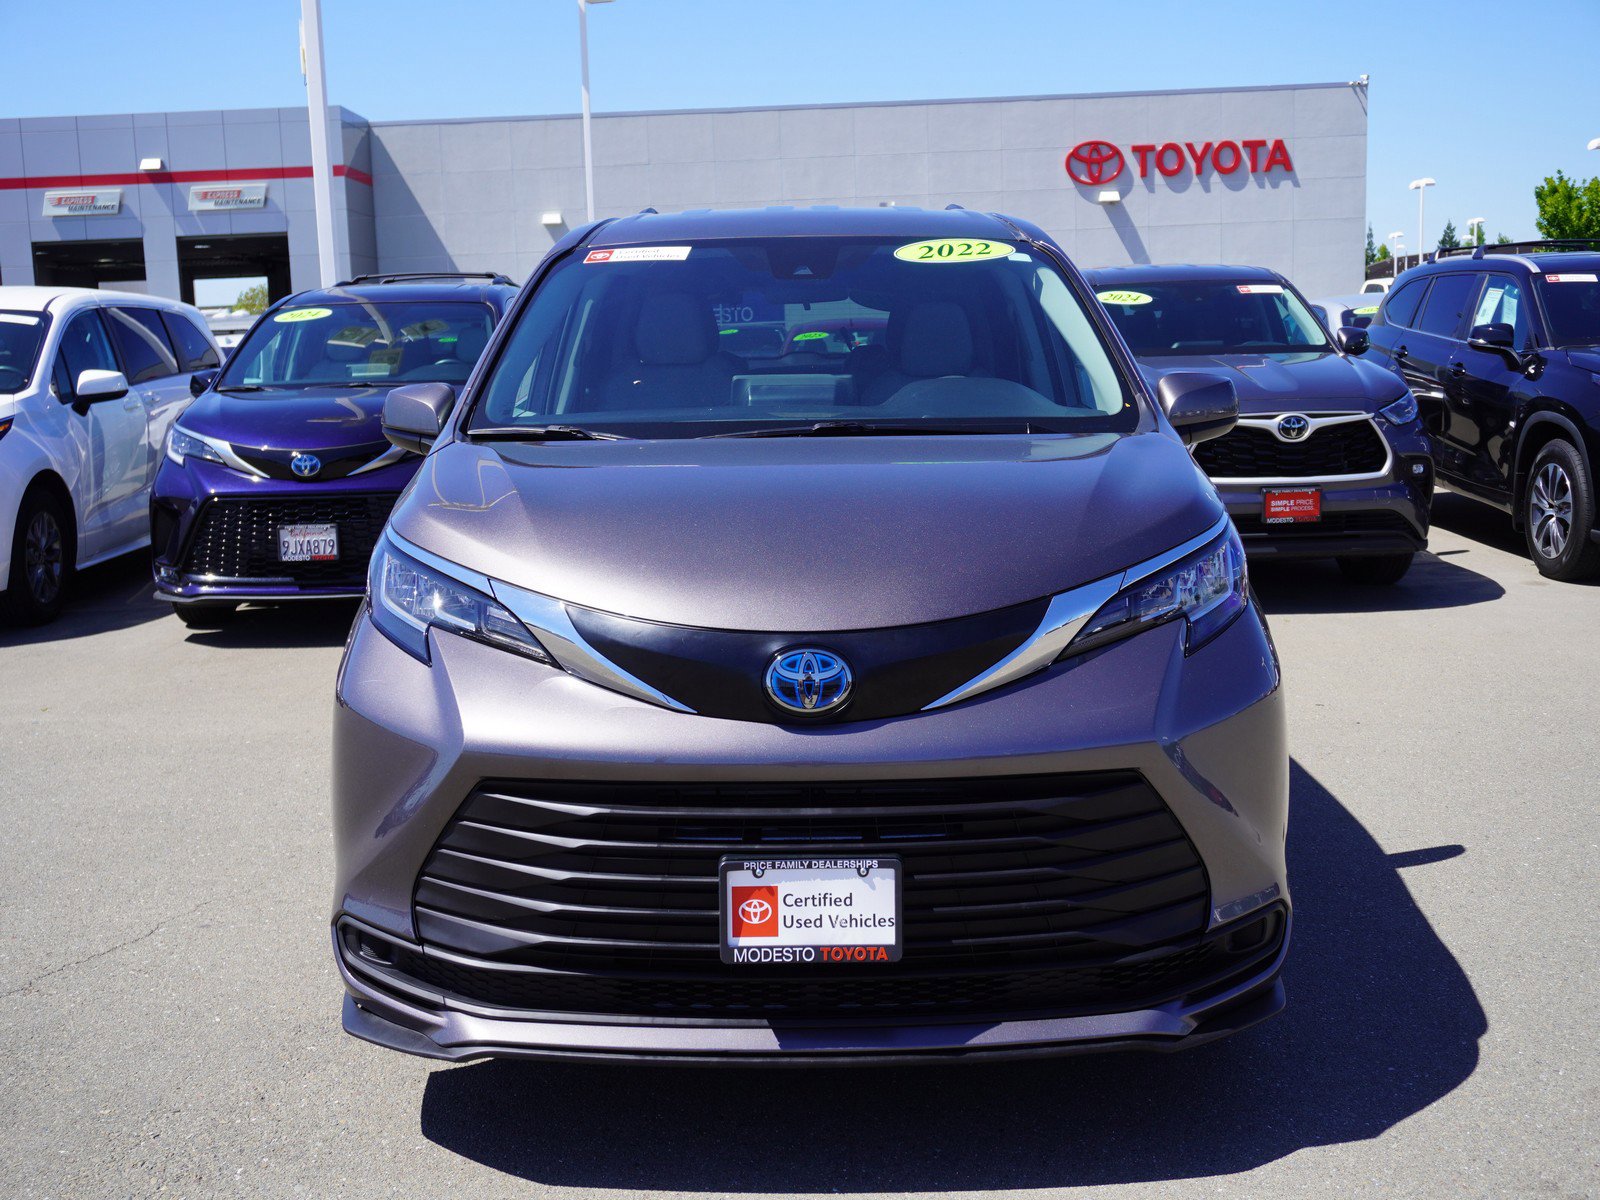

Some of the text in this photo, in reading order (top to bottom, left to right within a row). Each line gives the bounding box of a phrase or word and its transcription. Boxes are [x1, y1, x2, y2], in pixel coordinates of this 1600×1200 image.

[1131, 139, 1293, 178] TOYOTA
[68, 204, 116, 212] MAINTENANCE
[214, 198, 262, 206] MAINTENANCE
[918, 242, 991, 259] 2022
[1103, 293, 1142, 302] 2024
[283, 539, 334, 555] 9JXA879
[744, 859, 879, 870] PRICE FAMILY DEALERSHIPS
[783, 893, 853, 907] Certified
[783, 914, 895, 928] Used Vehicles
[734, 947, 889, 962] MODESTO TOYOTA
